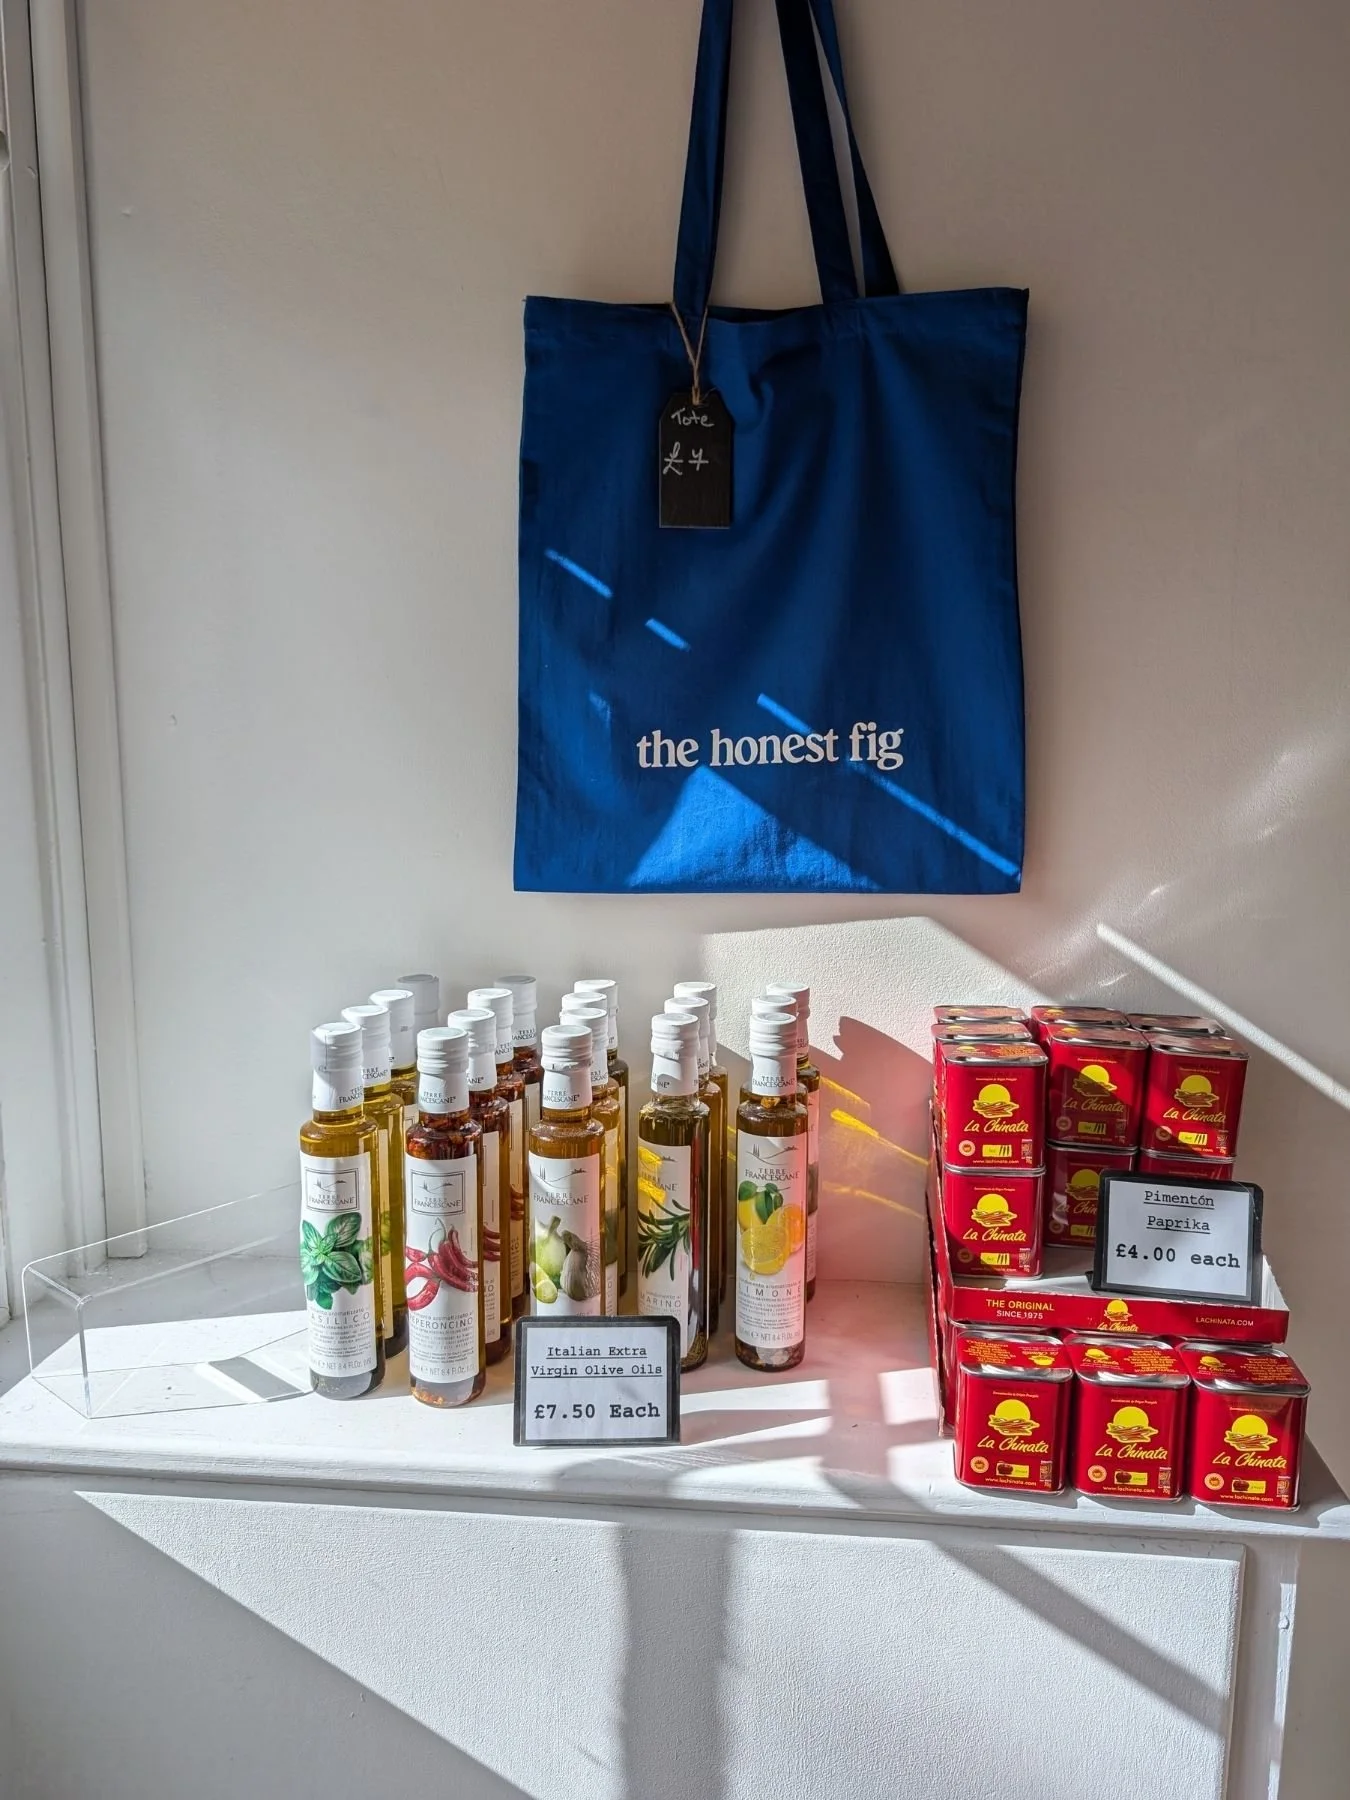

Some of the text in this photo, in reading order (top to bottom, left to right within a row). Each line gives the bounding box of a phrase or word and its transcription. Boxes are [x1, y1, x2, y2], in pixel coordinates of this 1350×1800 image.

[671, 408, 715, 427] Tote
[636, 722, 904, 771] the honest fig
[1062, 1096, 1124, 1112] La Chinata
[1163, 1107, 1226, 1123] La Chinata
[963, 1118, 1028, 1133] La Chinata
[745, 1169, 800, 1181] FRANCESCANE
[533, 1193, 589, 1206] FRANCESCANE
[1144, 1190, 1215, 1207] Pimentón
[1073, 1201, 1098, 1214] Chin
[1147, 1215, 1211, 1231] Paprika
[963, 1227, 1026, 1242] La Chinata
[1116, 1243, 1240, 1268] £4.00 each
[986, 1299, 1055, 1311] THE ORIGINAL
[996, 1310, 1043, 1320] SINCE 1975
[1110, 1322, 1139, 1333] Chinata
[547, 1346, 647, 1357] Italian Extra
[531, 1364, 662, 1377] Virgin Olive Oils
[534, 1403, 660, 1419] £7.50 Each
[977, 1435, 1049, 1453] La Chinata
[1095, 1443, 1168, 1460] La Chinata
[1212, 1451, 1287, 1468] La Chinata
